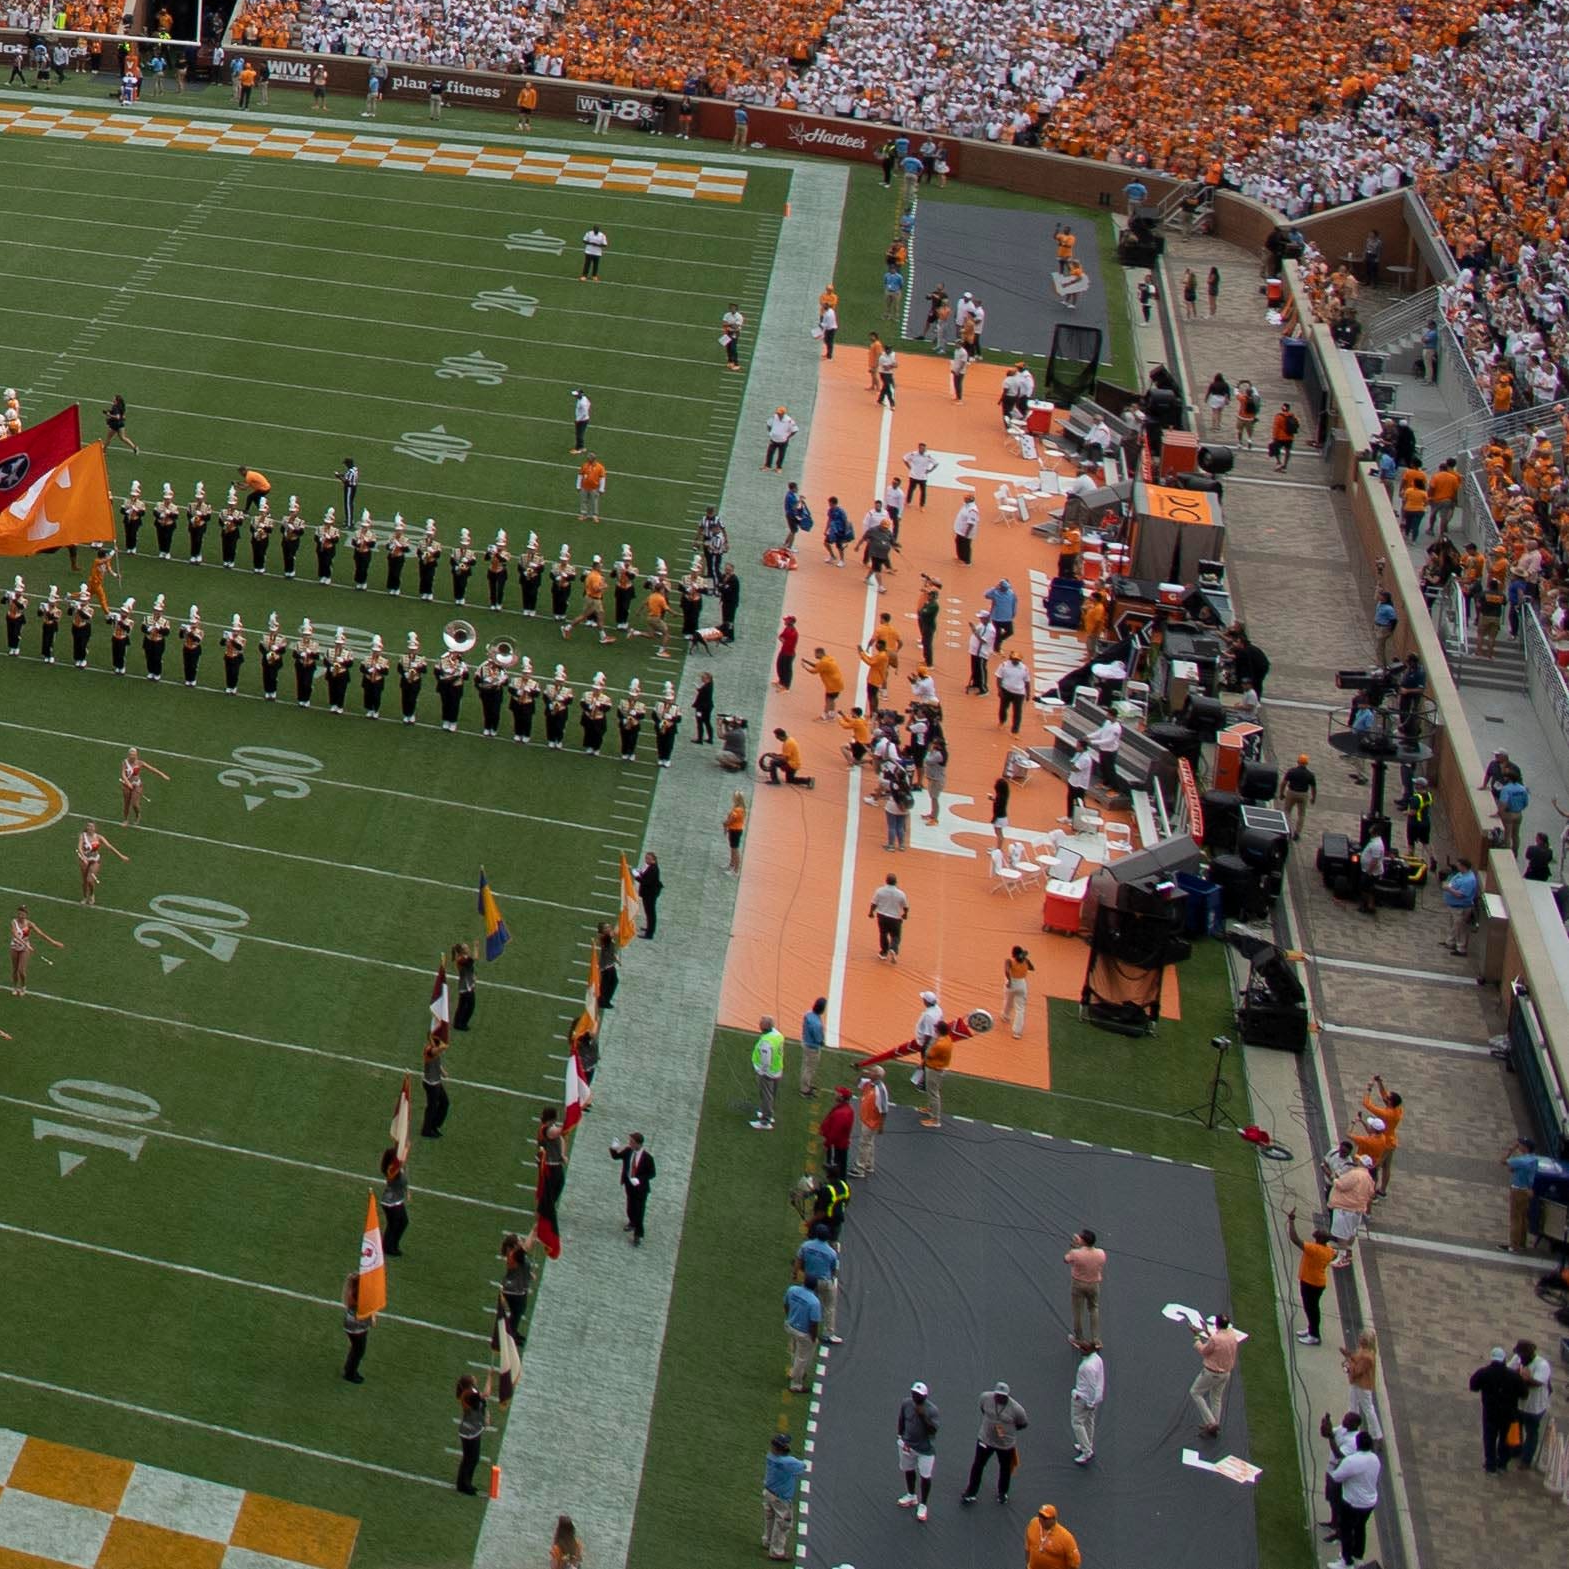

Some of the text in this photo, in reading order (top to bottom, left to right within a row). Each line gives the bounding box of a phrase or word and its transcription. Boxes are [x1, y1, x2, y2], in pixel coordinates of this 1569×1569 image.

[267, 60, 311, 76] WIVK
[446, 81, 501, 99] fitness
[804, 128, 867, 149] Hardee's
[134, 894, 250, 963] 20
[32, 1077, 161, 1163] 10
